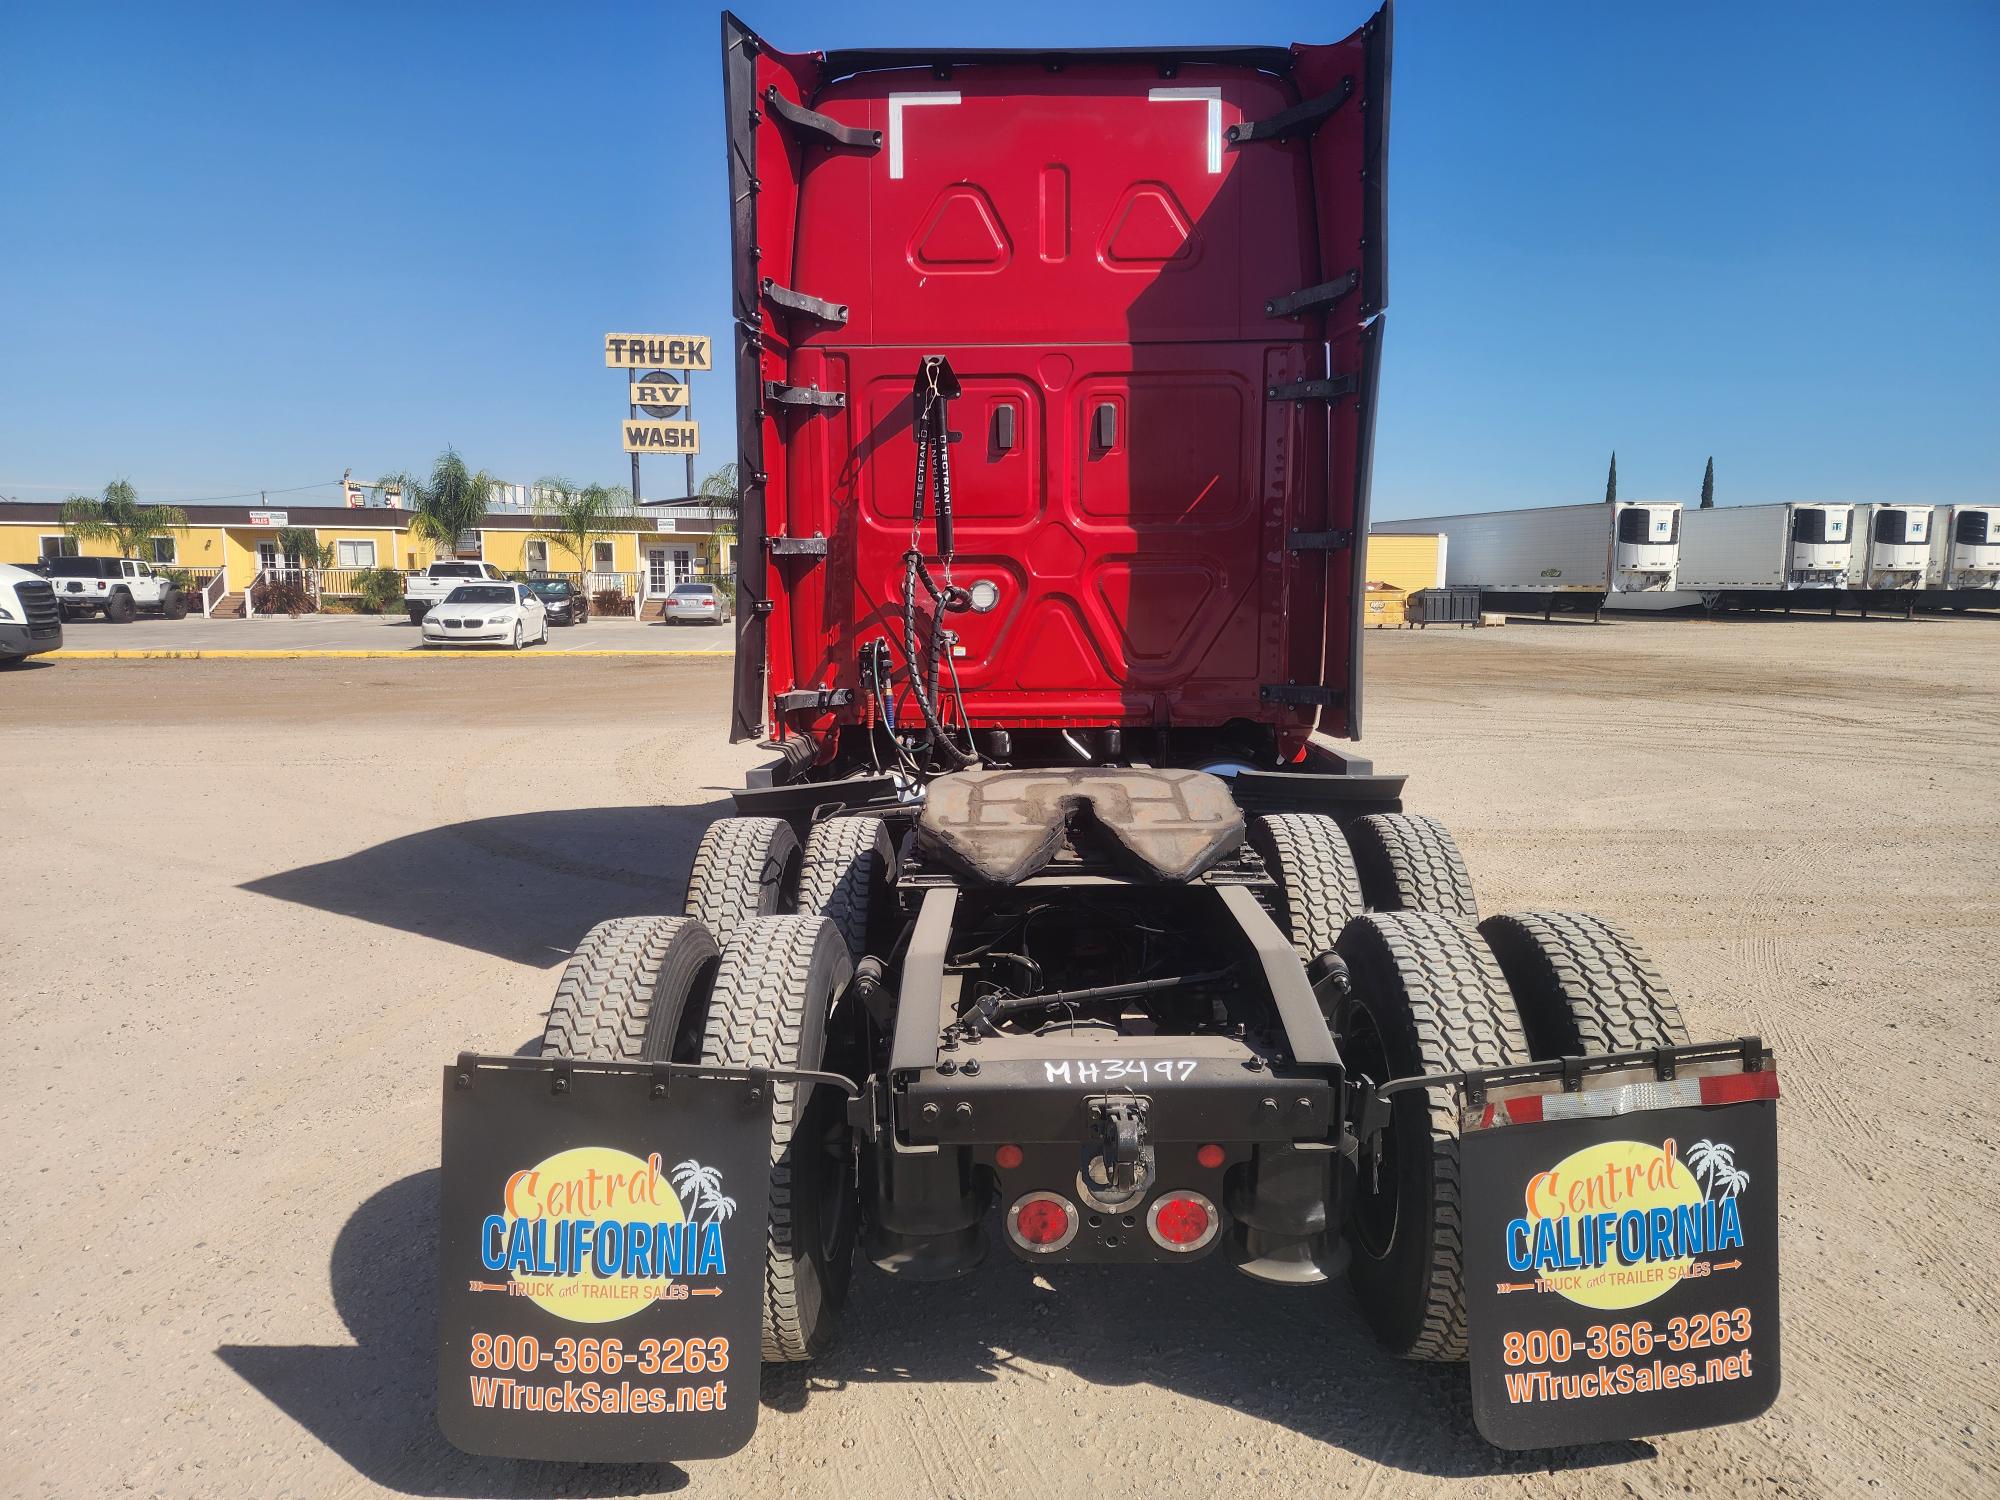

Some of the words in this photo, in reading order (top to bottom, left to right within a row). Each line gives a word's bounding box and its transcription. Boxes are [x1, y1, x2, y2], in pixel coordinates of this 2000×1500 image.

[608, 339, 706, 365] TRUCK
[636, 386, 683, 402] RV
[626, 427, 695, 447] WASH
[916, 441, 927, 498] TECTRAN
[931, 449, 940, 506] TECTRAN
[941, 446, 950, 503] TECTRAN
[1044, 1059, 1198, 1084] MH3497
[504, 1152, 663, 1223] Central
[1524, 1137, 1678, 1222] Central
[481, 1214, 727, 1276] CALIFORNIA
[1506, 1196, 1744, 1272] CALIFORNIA
[507, 1281, 554, 1298] TRUCK
[558, 1280, 580, 1298] and
[581, 1285, 640, 1300] TRAILER
[643, 1285, 689, 1300] SALES
[1534, 1277, 1582, 1293] TRUCK
[1586, 1272, 1607, 1289] and
[1608, 1268, 1664, 1287] TRAILER
[1667, 1261, 1711, 1280] SALES
[470, 1332, 730, 1375] 800-366-3263
[1503, 1307, 1752, 1366] 800-366-3263
[470, 1374, 728, 1414] WTruckSales.net
[1504, 1348, 1753, 1404] WTruckSales.net
